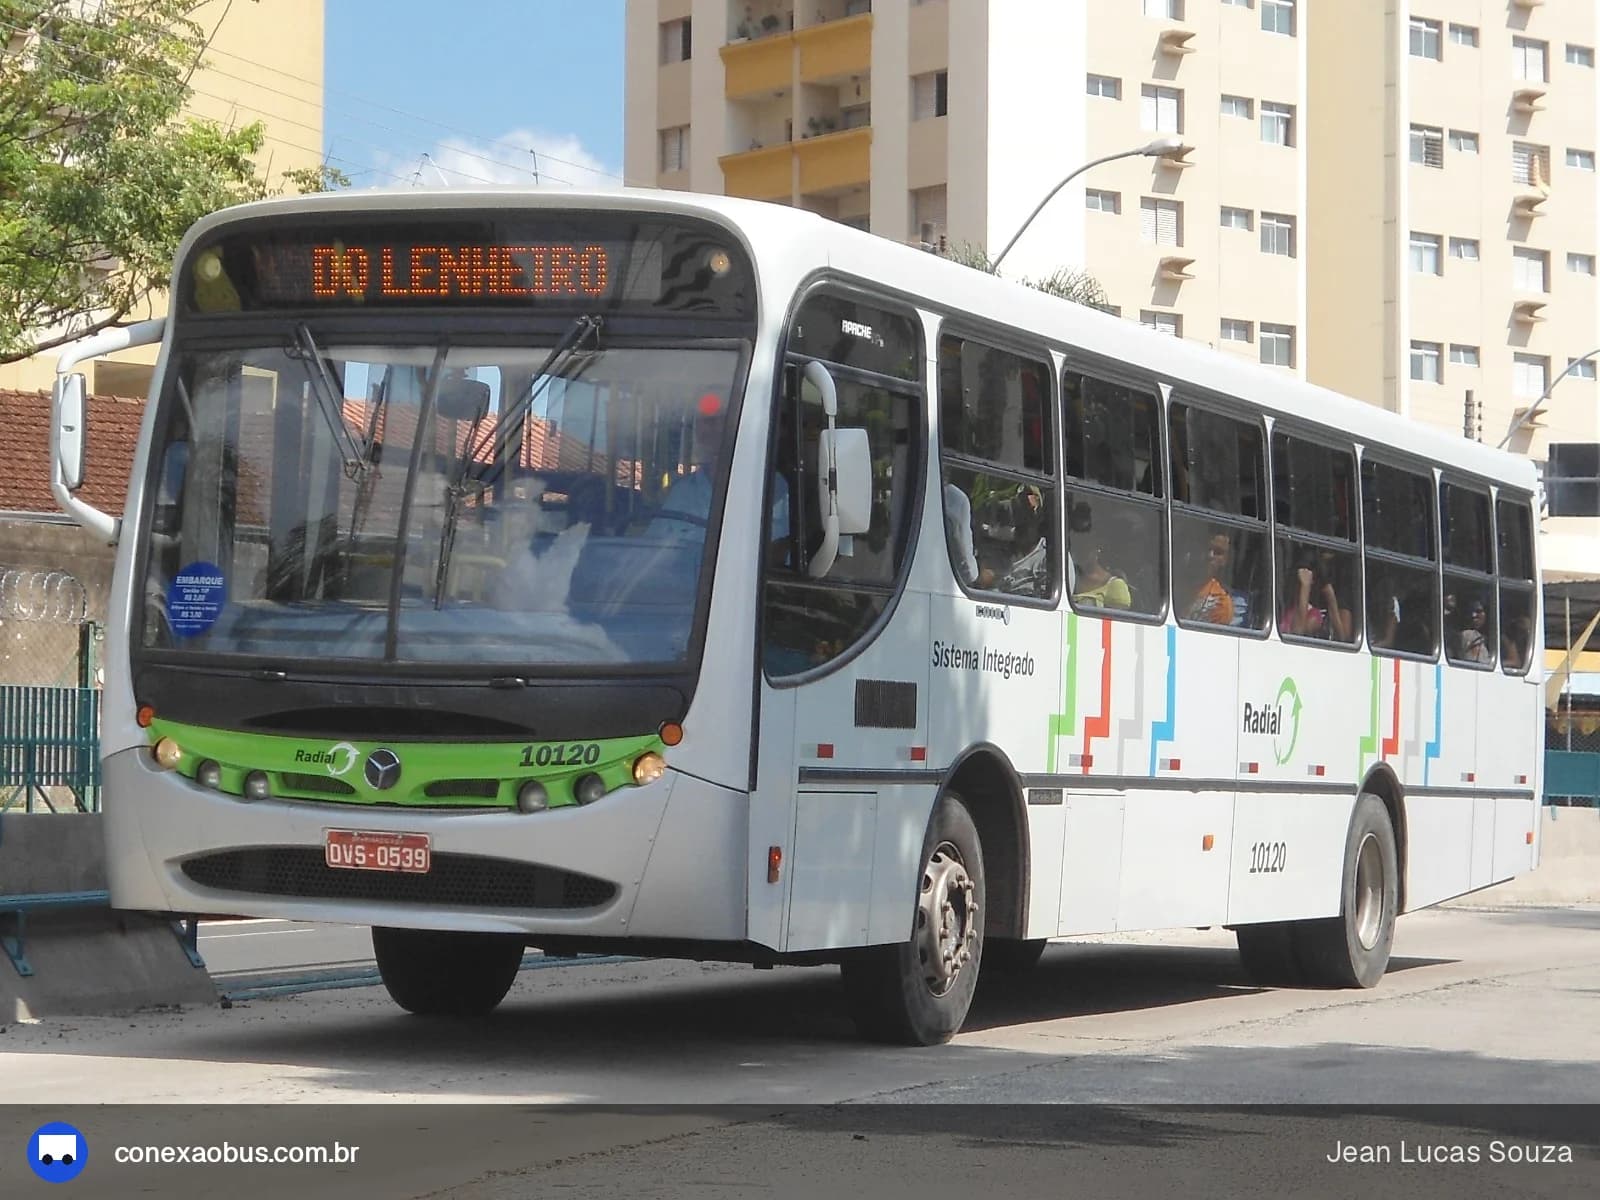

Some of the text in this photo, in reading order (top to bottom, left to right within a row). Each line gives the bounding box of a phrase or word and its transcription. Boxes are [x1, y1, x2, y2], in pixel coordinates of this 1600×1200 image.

[312, 247, 608, 295] DO LENHEIRO
[842, 319, 872, 339] APACHE
[176, 576, 224, 585] EMBARQUE
[932, 640, 1035, 680] Sistema Integrado
[1243, 702, 1282, 735] Radial
[295, 749, 336, 765] Radial
[519, 743, 600, 767] 10120
[1249, 841, 1287, 874] 10120
